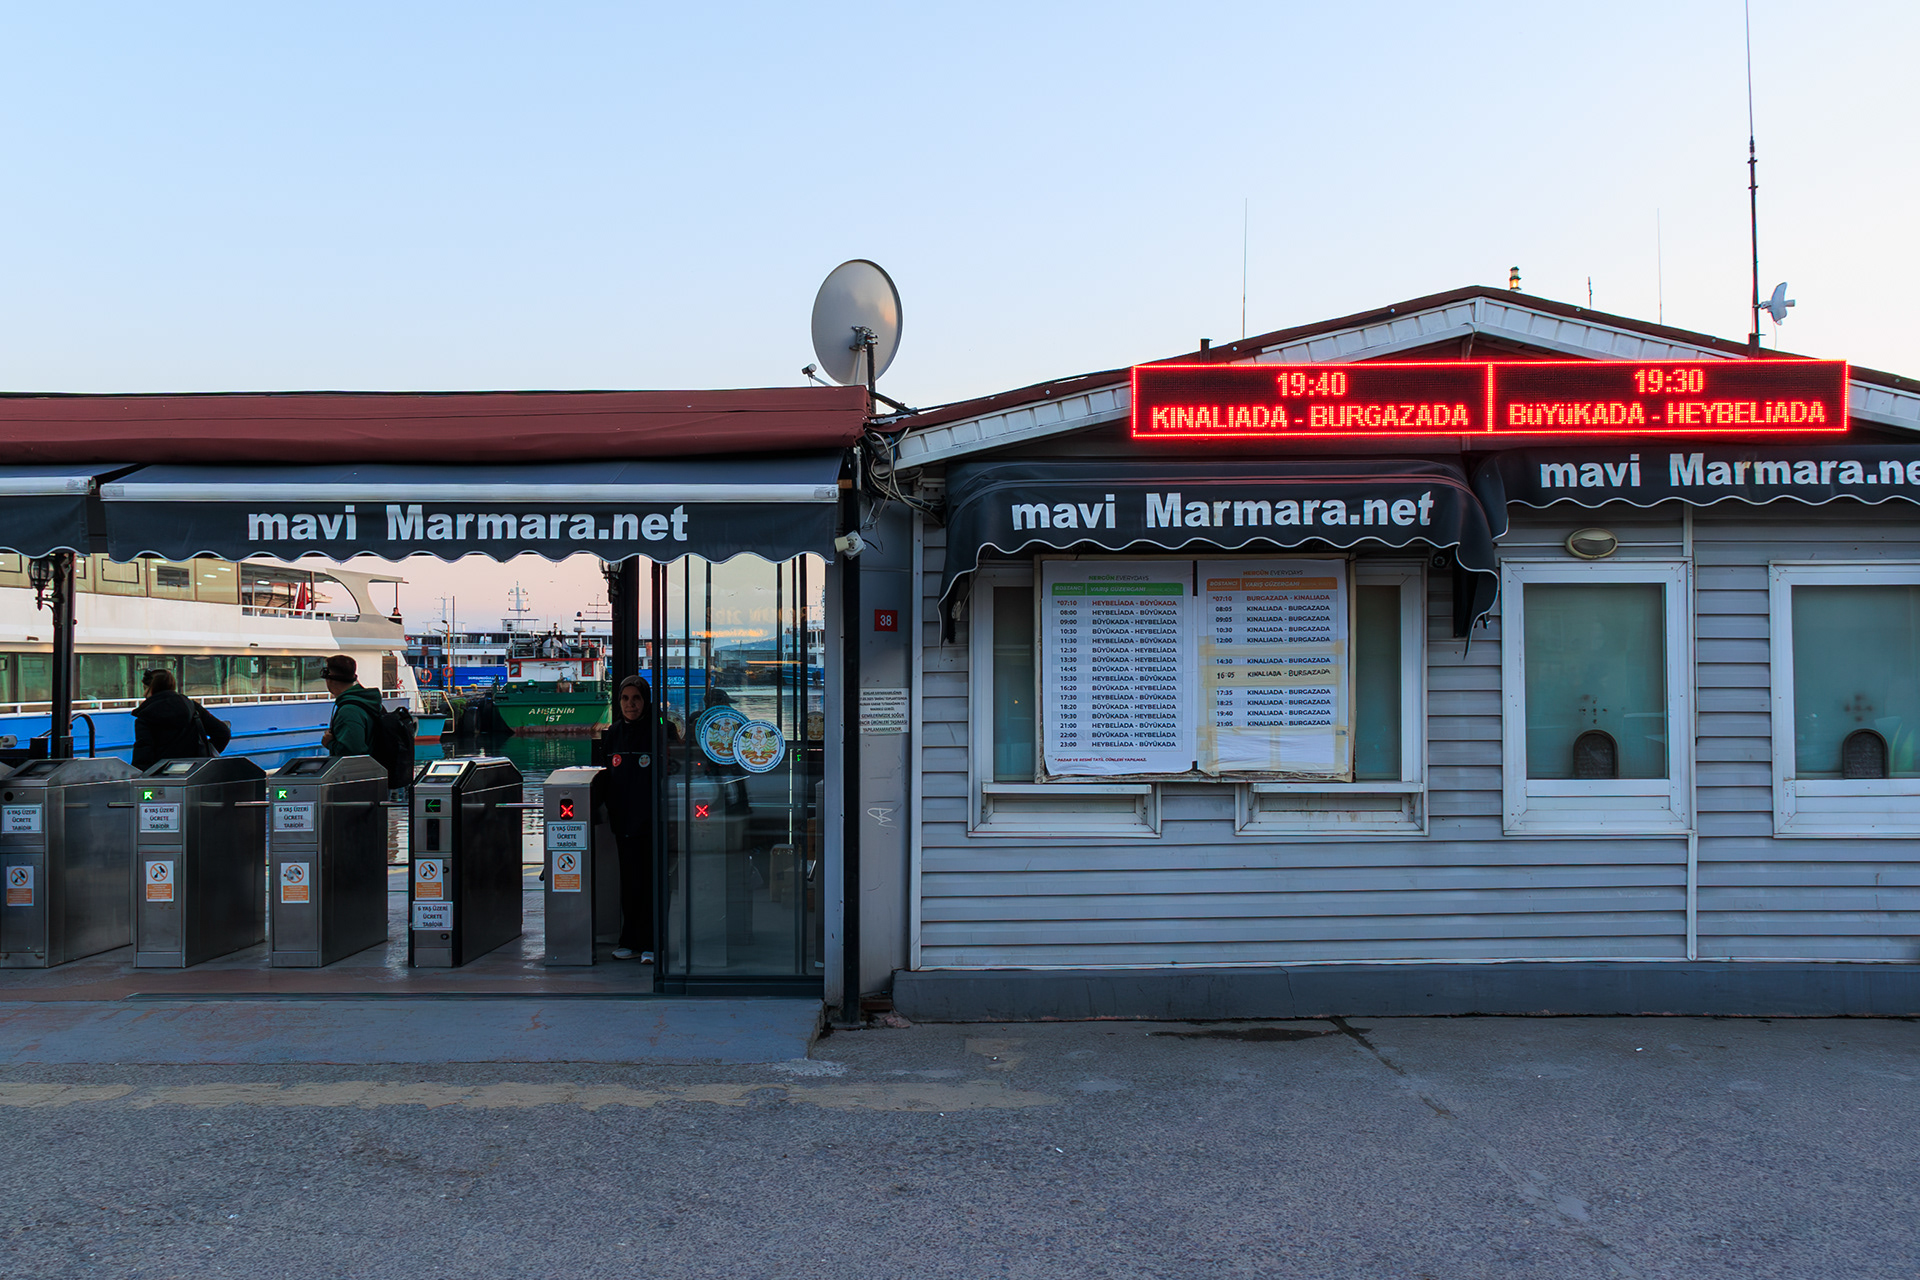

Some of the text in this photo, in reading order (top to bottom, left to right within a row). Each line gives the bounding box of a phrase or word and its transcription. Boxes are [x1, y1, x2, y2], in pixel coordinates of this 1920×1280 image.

[1276, 372, 1346, 396] 19:40
[1634, 369, 1704, 393] 19:30
[1152, 406, 1288, 429] KINALIADA
[1310, 404, 1469, 427] BURGAZADA
[1540, 454, 1640, 488] mavi
[248, 504, 688, 541] mavi Marmara.net
[1012, 491, 1434, 530] mavi Marmara.net
[880, 614, 892, 626] 38
